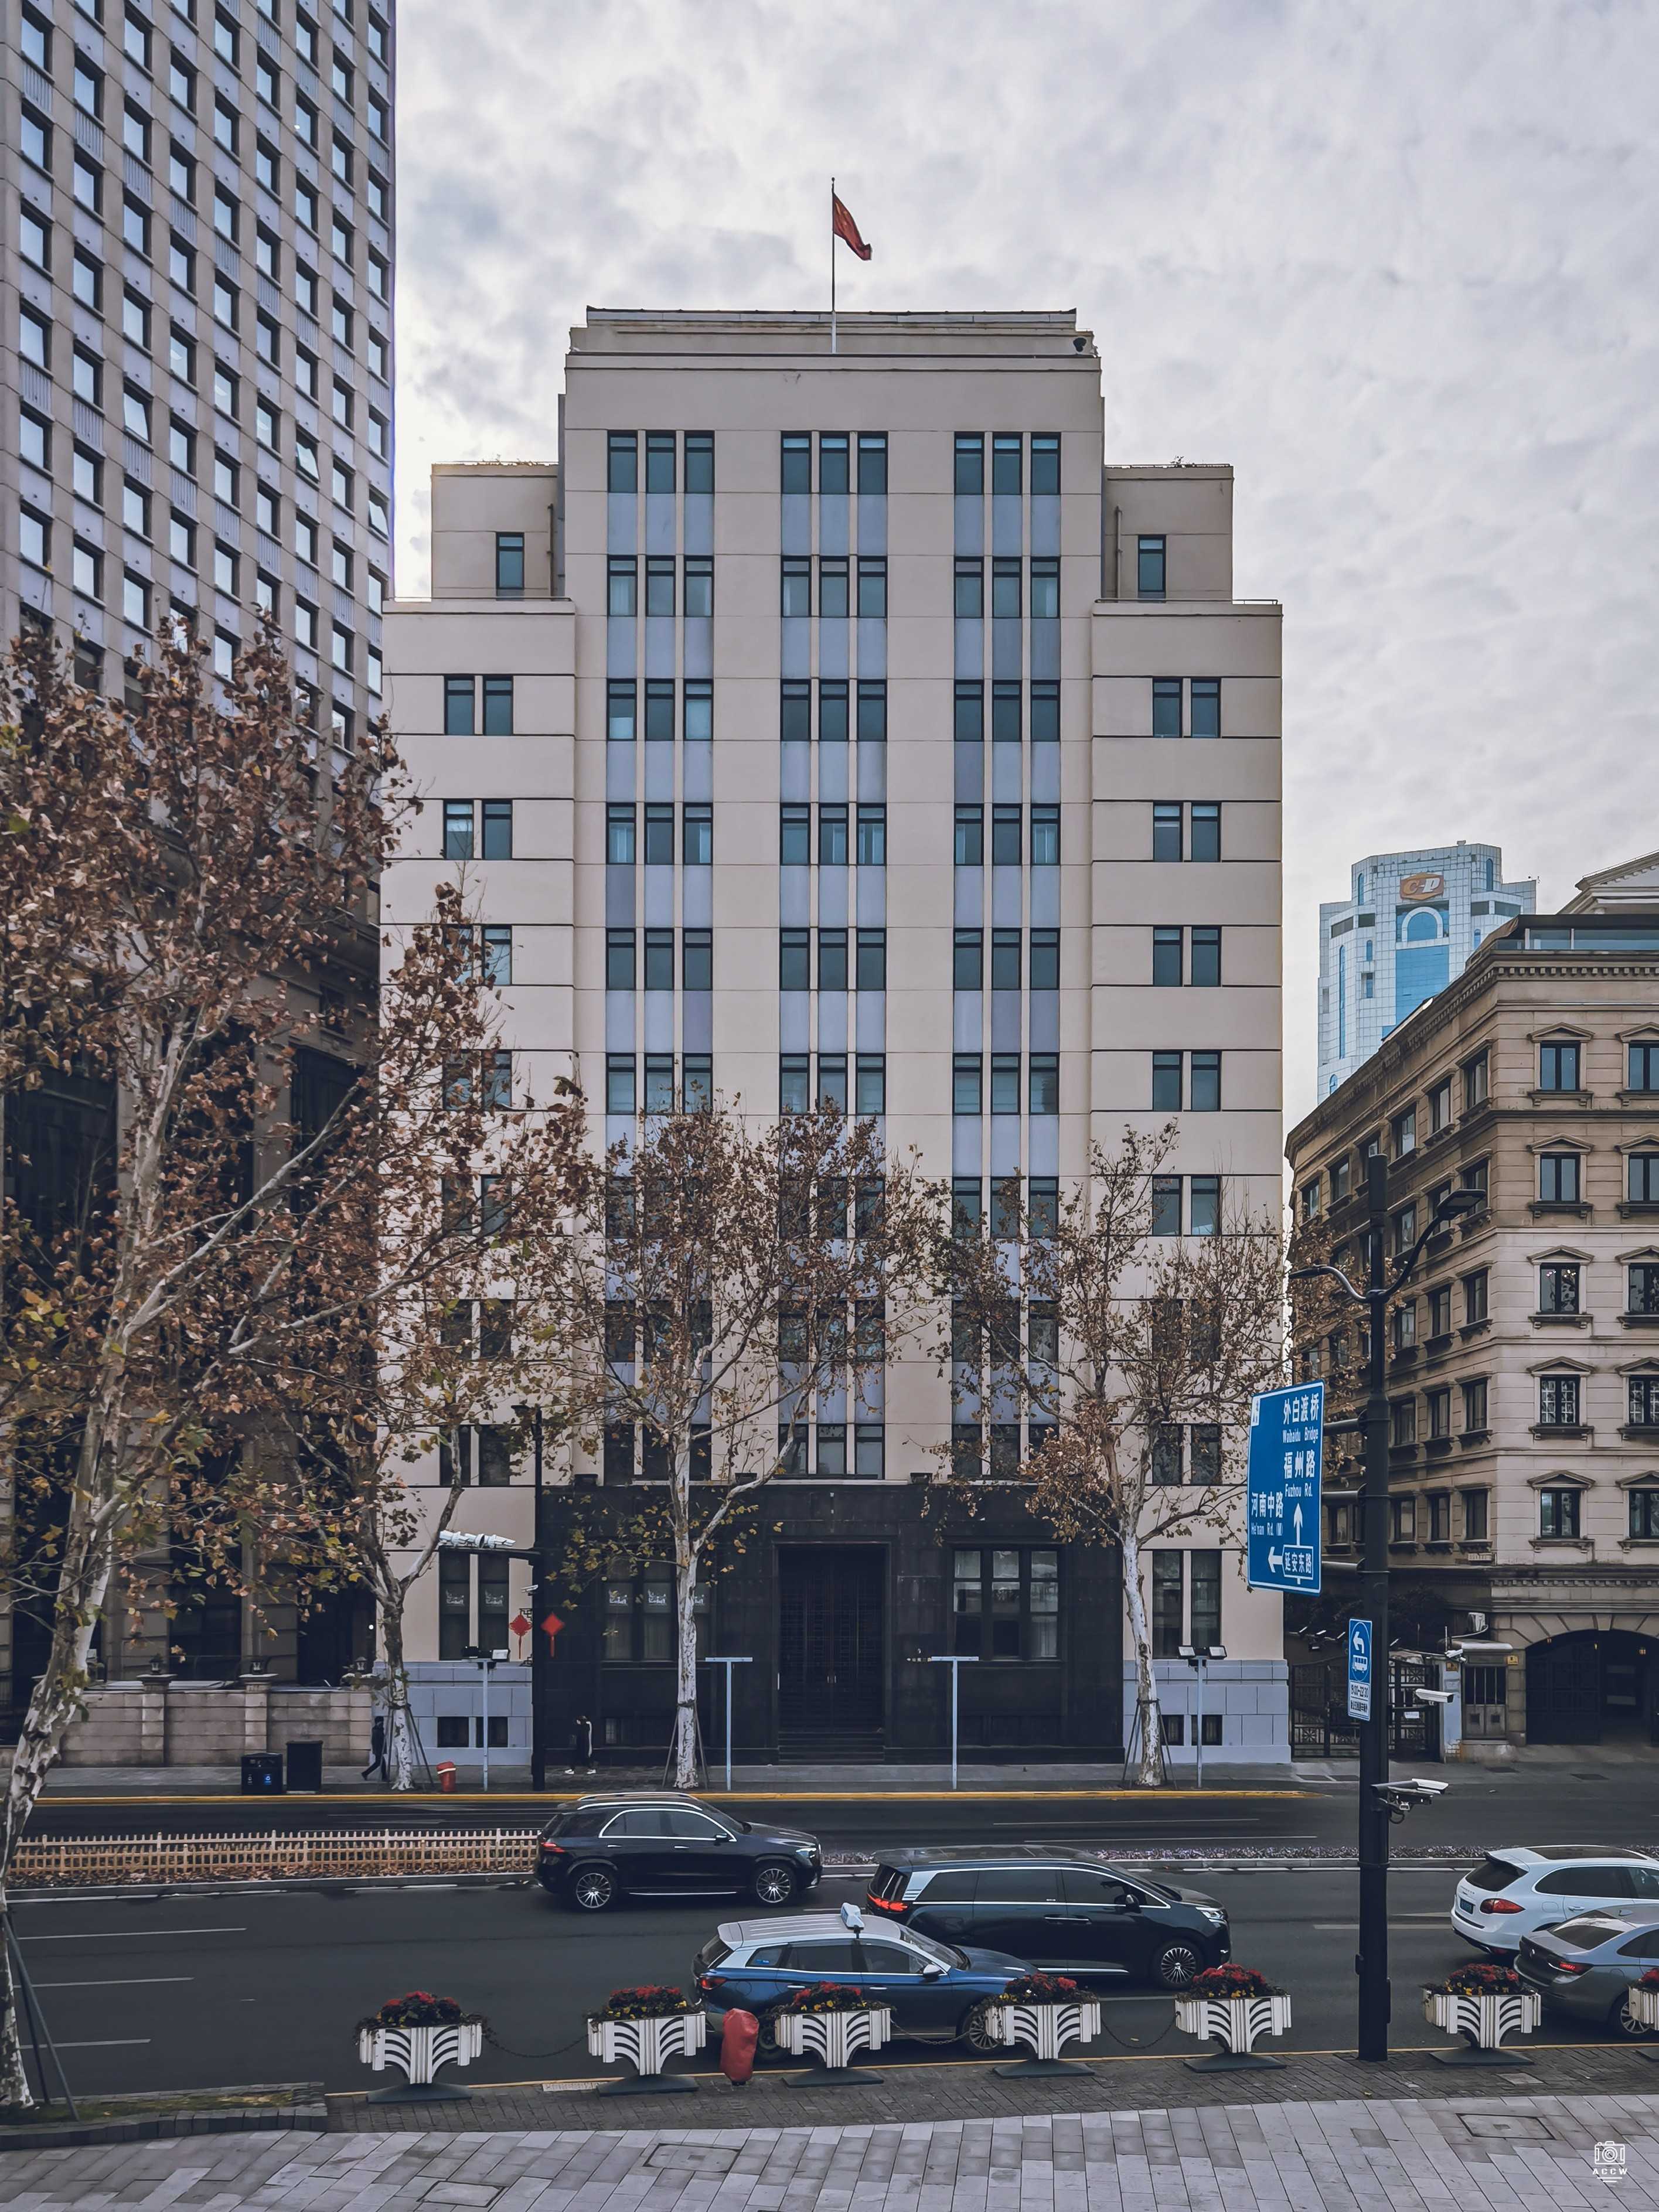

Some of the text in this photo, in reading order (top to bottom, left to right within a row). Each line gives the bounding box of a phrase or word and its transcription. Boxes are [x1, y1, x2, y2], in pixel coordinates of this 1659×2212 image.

[1283, 1392, 1319, 1424] 外白渡桥
[1282, 1426, 1319, 1444] Waibaidu Bridge
[1283, 1449, 1316, 1480] 福州路
[1285, 1482, 1313, 1497] Fuzhou Rd.
[1251, 1491, 1283, 1518] 河南中路
[1285, 1552, 1311, 1574] 延安东路
